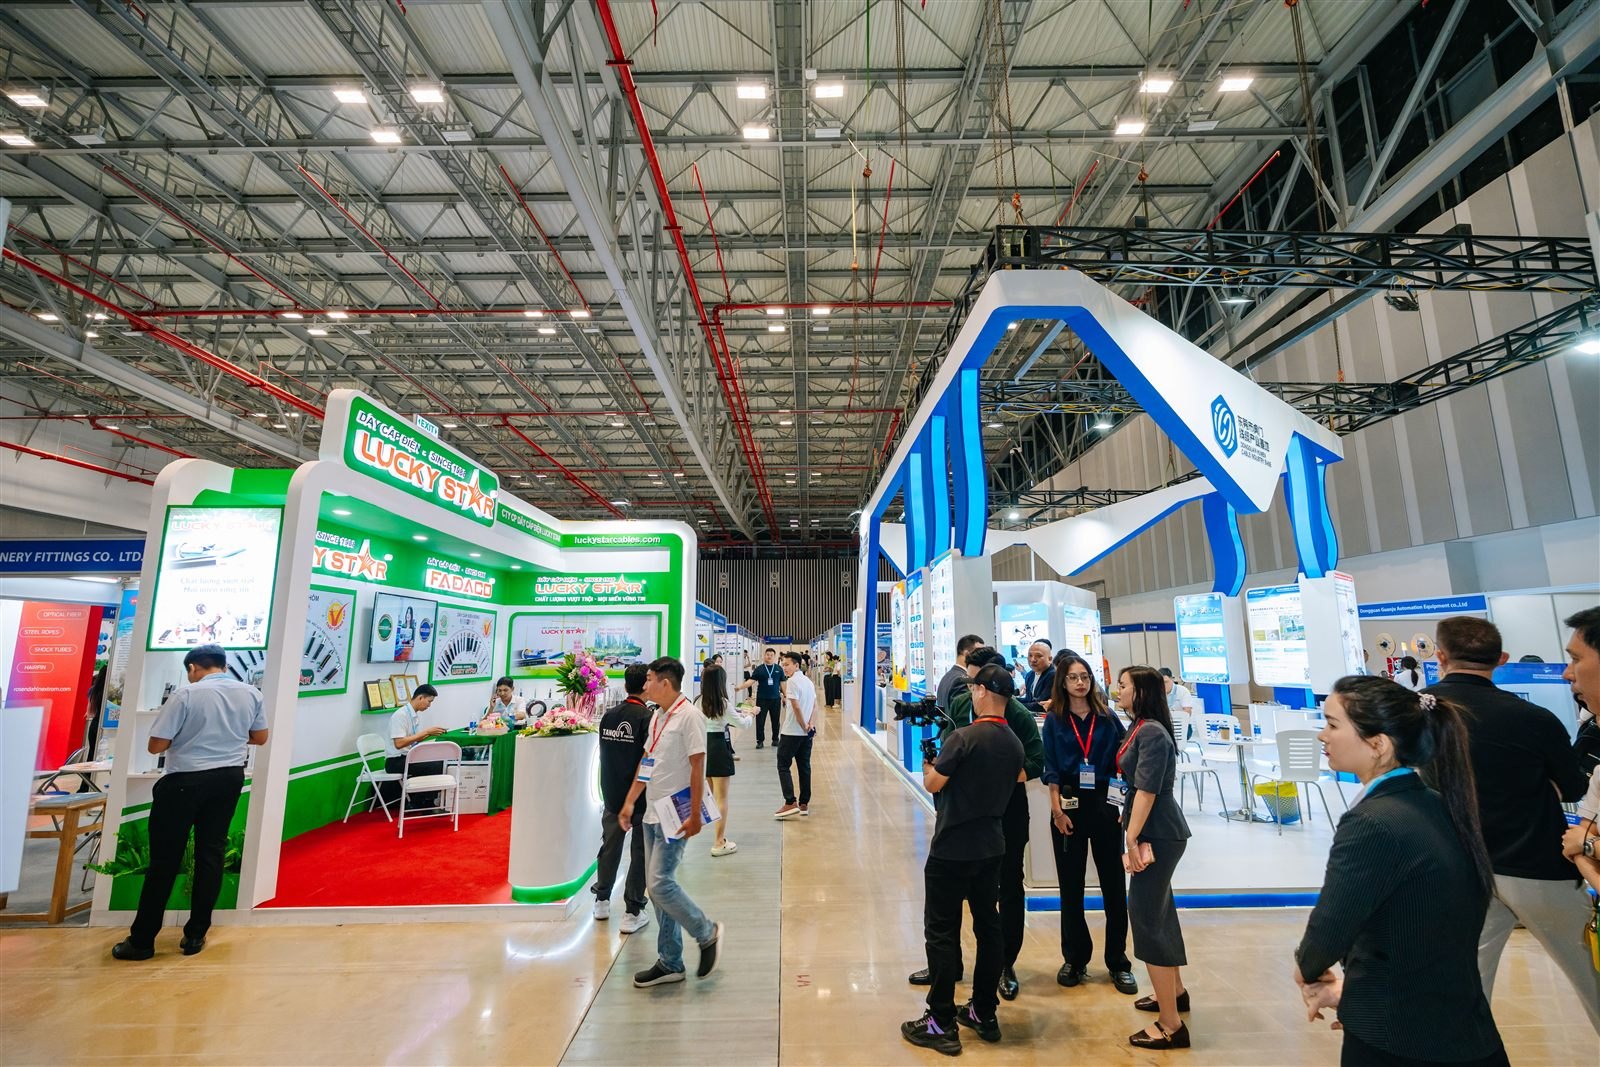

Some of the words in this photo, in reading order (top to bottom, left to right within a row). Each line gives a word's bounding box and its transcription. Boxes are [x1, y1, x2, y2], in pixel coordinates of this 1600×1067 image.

[419, 420, 436, 434] EXIT
[429, 451, 451, 471] SINCE
[358, 430, 440, 491] LUCKY
[442, 473, 495, 519] STAR
[316, 531, 339, 544] SINCE
[574, 536, 661, 545] luckystarcables.com
[0, 551, 32, 562] NERY
[34, 551, 90, 562] FITTINGS
[92, 551, 114, 562] CO.
[314, 546, 327, 566] Y
[330, 542, 387, 580] STAR
[429, 569, 492, 598] FADACO
[535, 583, 589, 594] LUCKY
[592, 575, 642, 594] STAR
